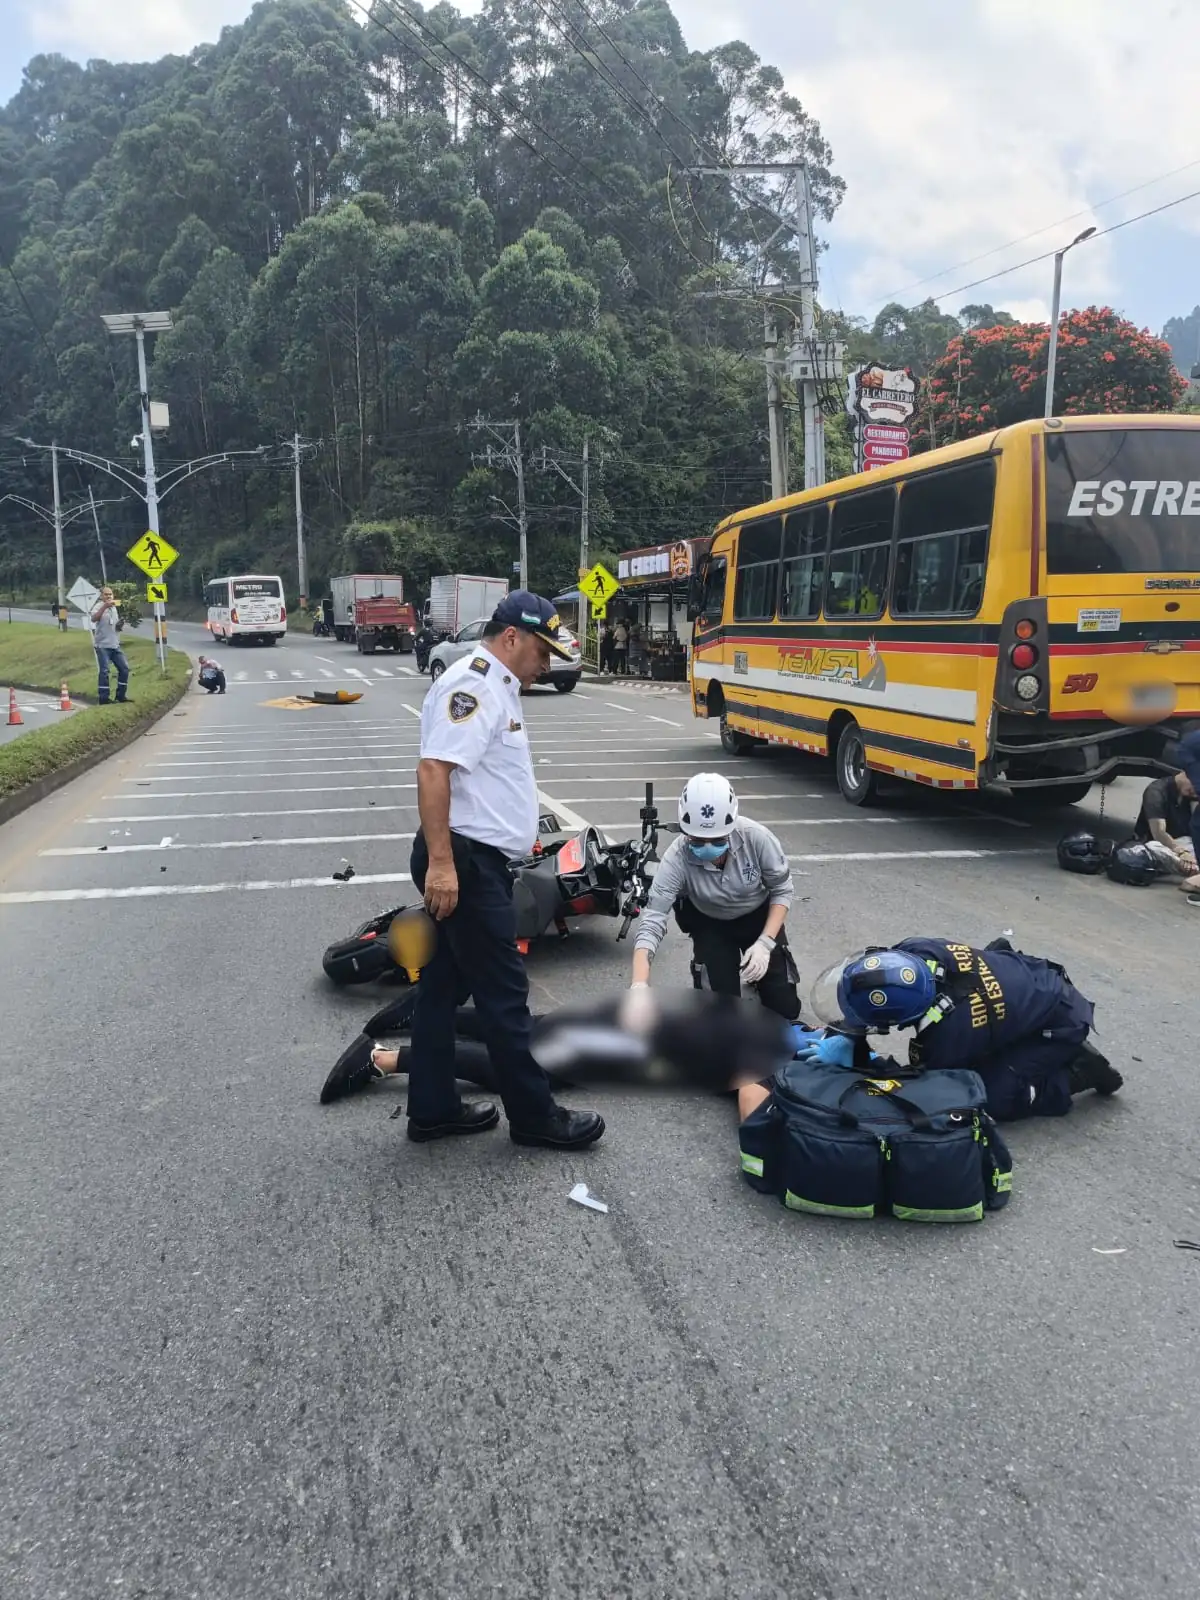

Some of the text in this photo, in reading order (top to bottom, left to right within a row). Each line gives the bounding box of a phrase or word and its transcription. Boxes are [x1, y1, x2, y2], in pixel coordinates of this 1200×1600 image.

[862, 388, 914, 402] EL CARRETERO
[778, 646, 859, 680] TEMSA
[1061, 673, 1098, 694] 50
